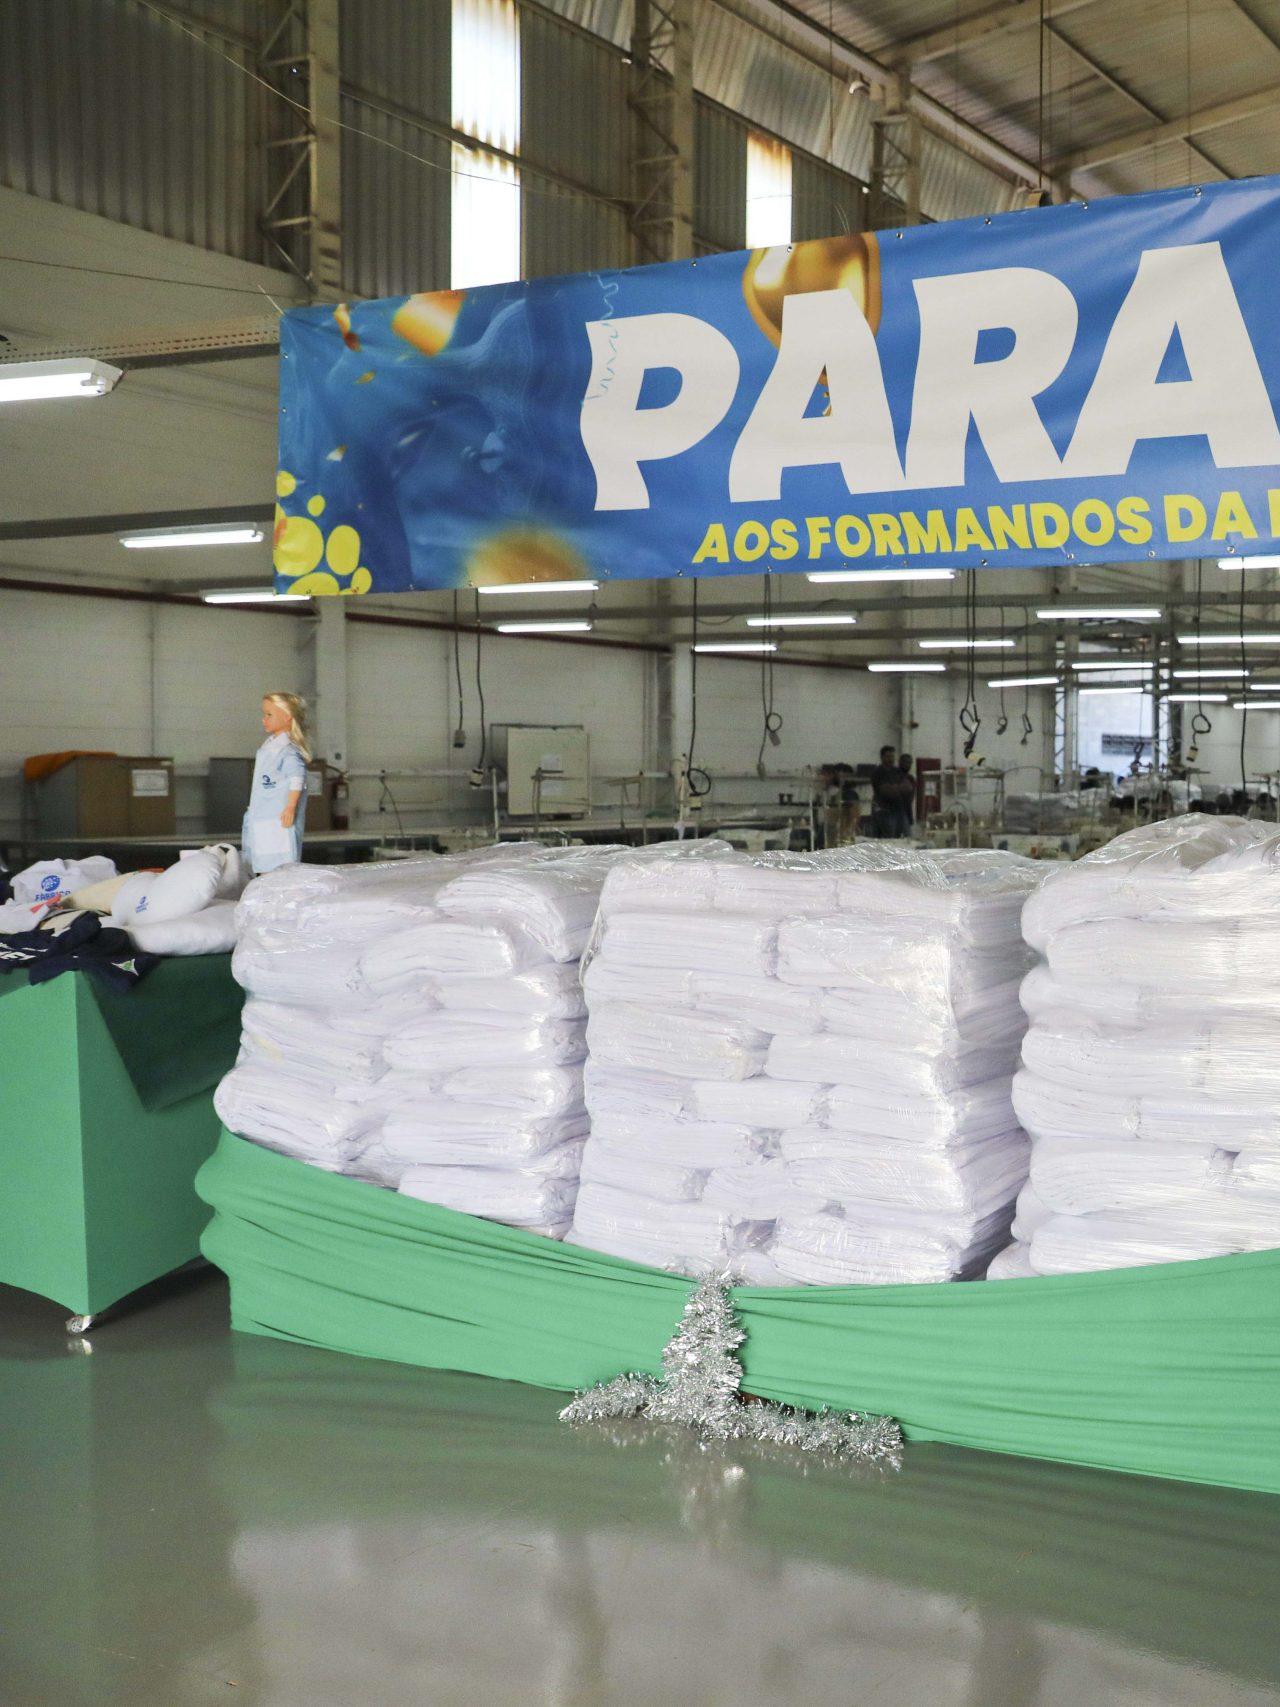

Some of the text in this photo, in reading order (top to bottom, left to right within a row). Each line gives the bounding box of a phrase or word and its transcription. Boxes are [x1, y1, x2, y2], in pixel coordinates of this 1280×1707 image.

[691, 518, 799, 563] AOS
[804, 496, 1154, 560] FORMANDOS
[1163, 490, 1254, 543] DA
